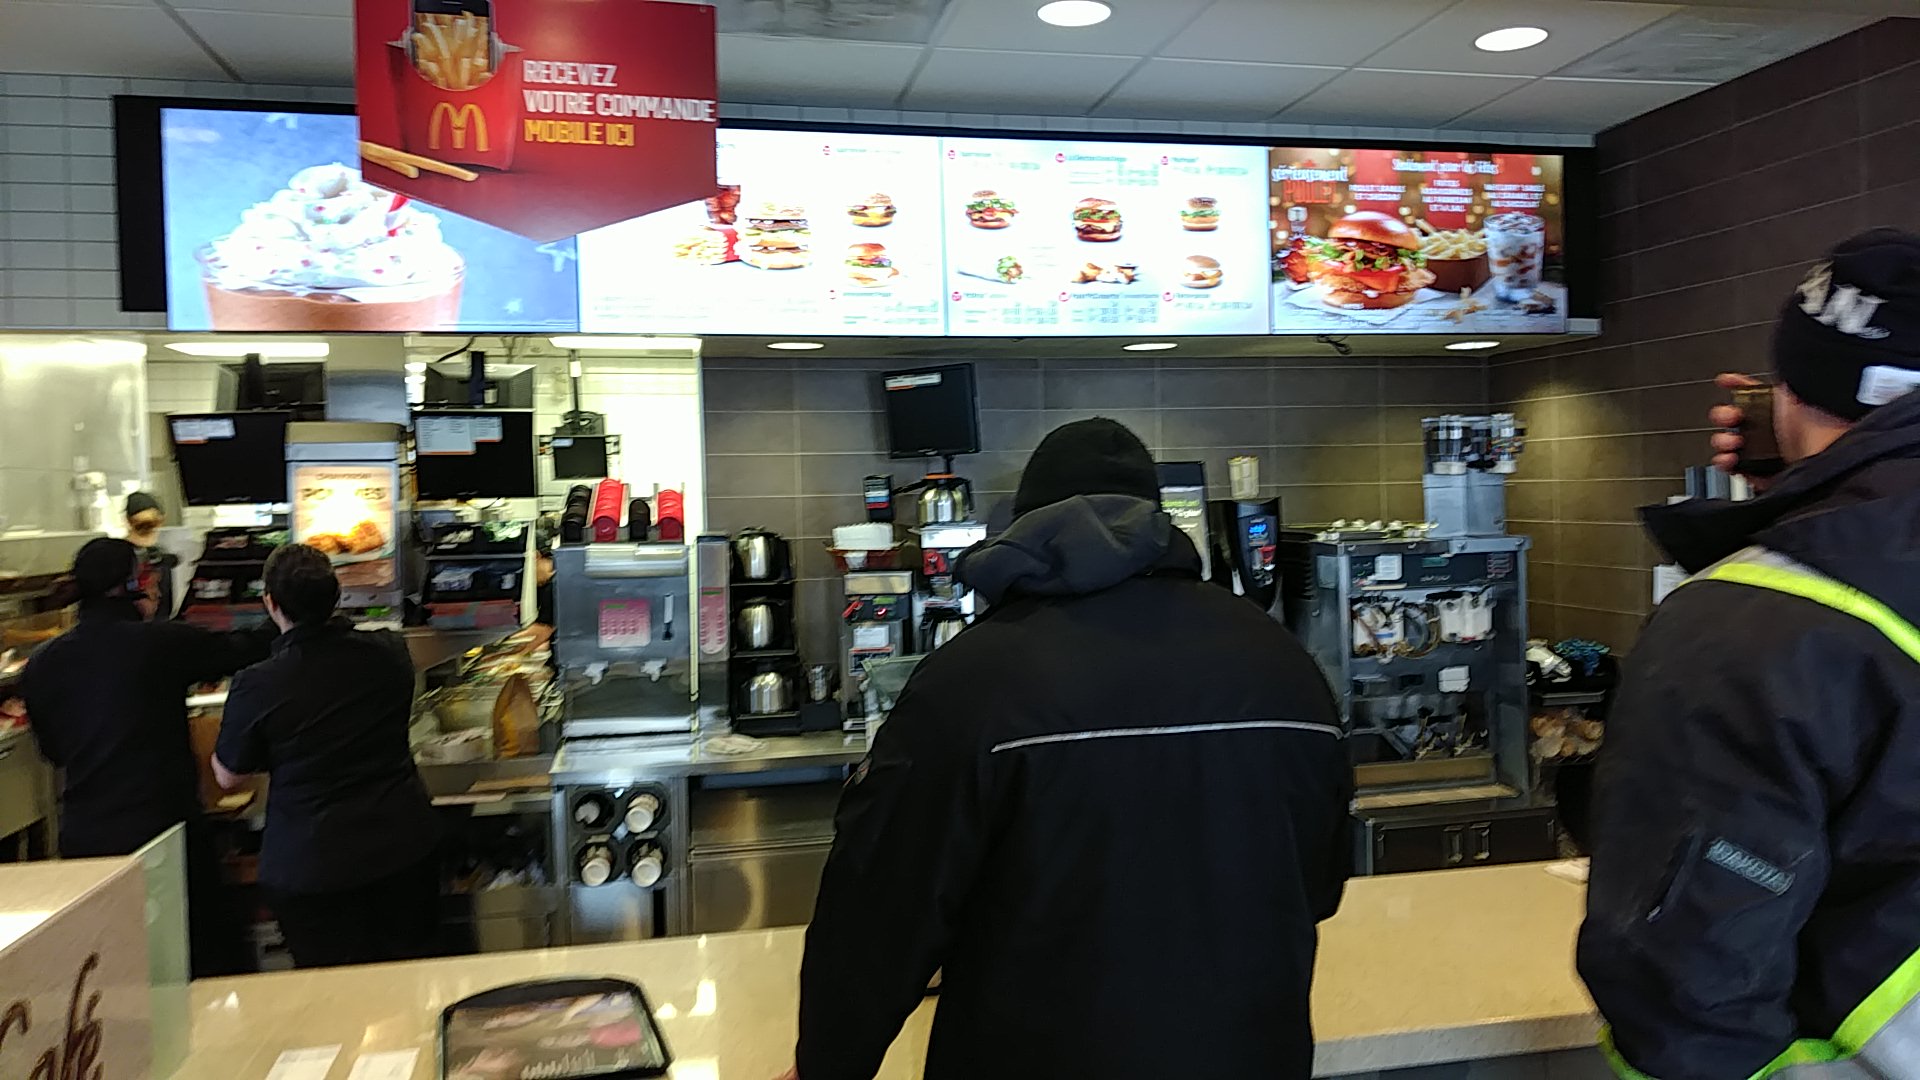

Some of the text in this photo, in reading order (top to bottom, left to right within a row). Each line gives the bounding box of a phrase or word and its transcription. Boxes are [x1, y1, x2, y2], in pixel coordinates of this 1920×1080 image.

[523, 60, 617, 87] RECEVEZ
[522, 89, 716, 122] VOTRE COMMANDE
[523, 118, 635, 146] MOBILE ICI
